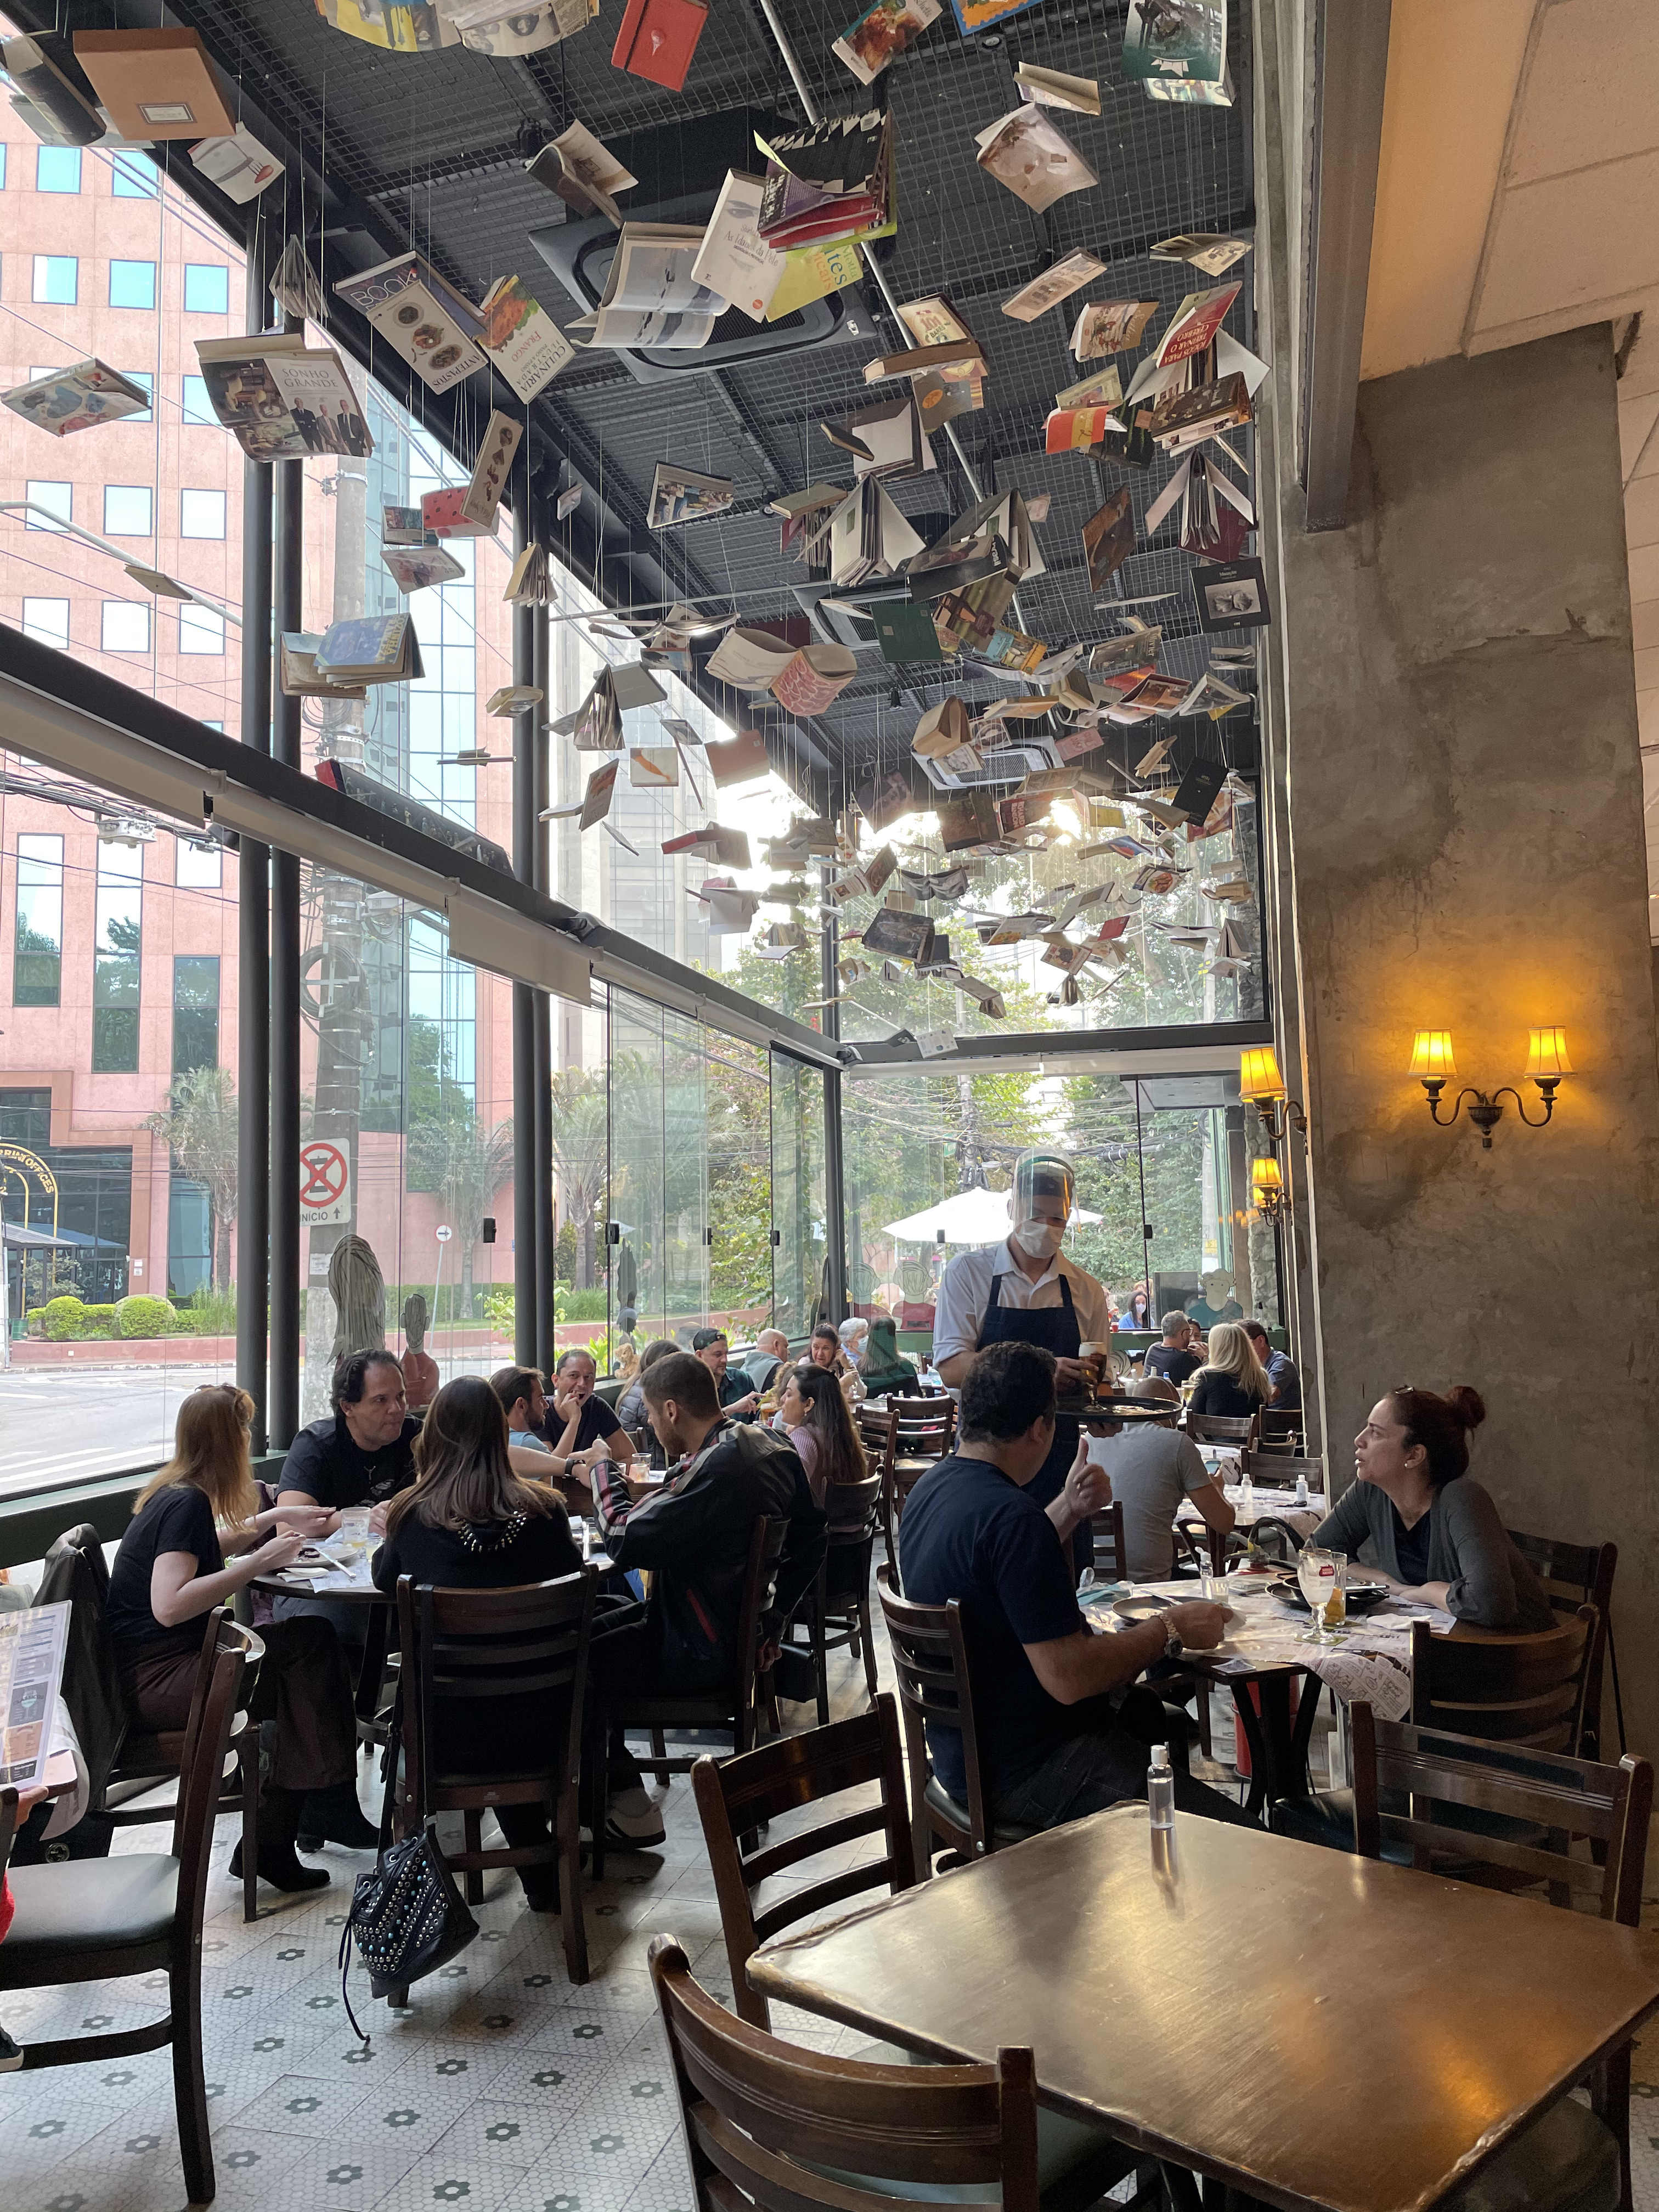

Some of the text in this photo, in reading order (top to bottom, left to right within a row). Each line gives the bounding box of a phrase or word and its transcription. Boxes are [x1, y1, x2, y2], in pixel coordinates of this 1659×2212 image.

[350, 270, 415, 306] BOOK
[511, 331, 542, 362] FRANGO
[930, 325, 946, 338] BARES
[283, 368, 329, 379] SONHO
[284, 379, 338, 387] GRANDE
[432, 355, 481, 388] ANTEPASTOS
[521, 346, 566, 392] CULINÁRIA
[25, 1158, 54, 1193] OFFICES
